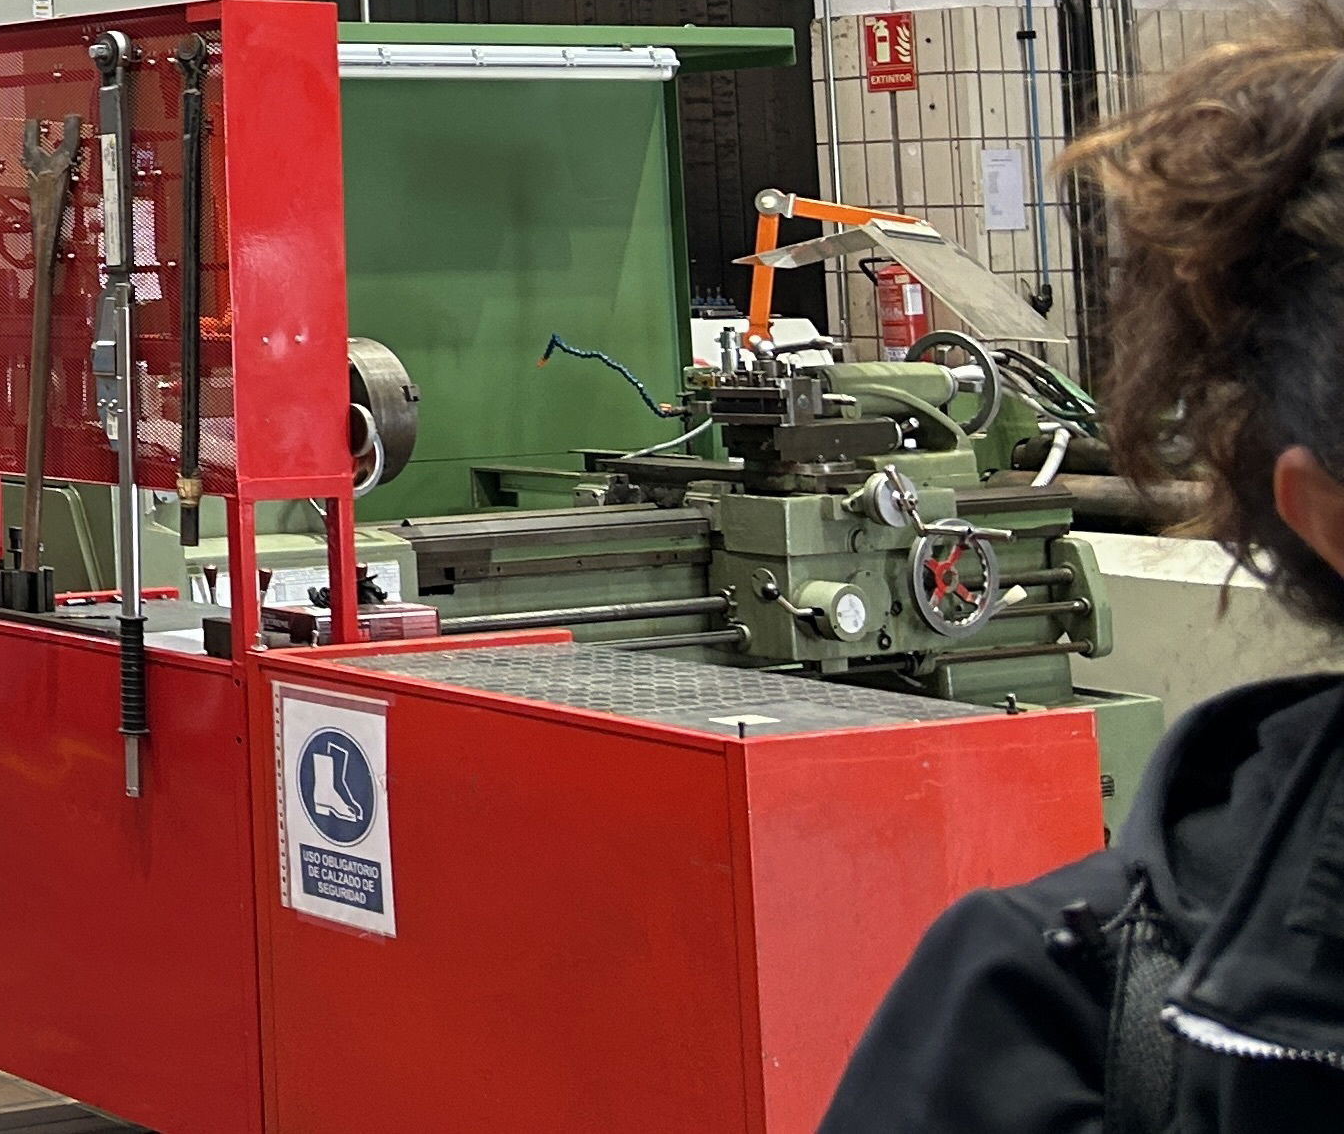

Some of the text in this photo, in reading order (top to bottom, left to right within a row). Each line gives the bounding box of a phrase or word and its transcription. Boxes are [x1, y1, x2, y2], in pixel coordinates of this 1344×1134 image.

[870, 73, 912, 85] EXTINTOR
[302, 849, 379, 879] USO OBLIGATORIO
[308, 864, 375, 893] DE CALZADO DE
[317, 881, 367, 905] SEGURIDAD
